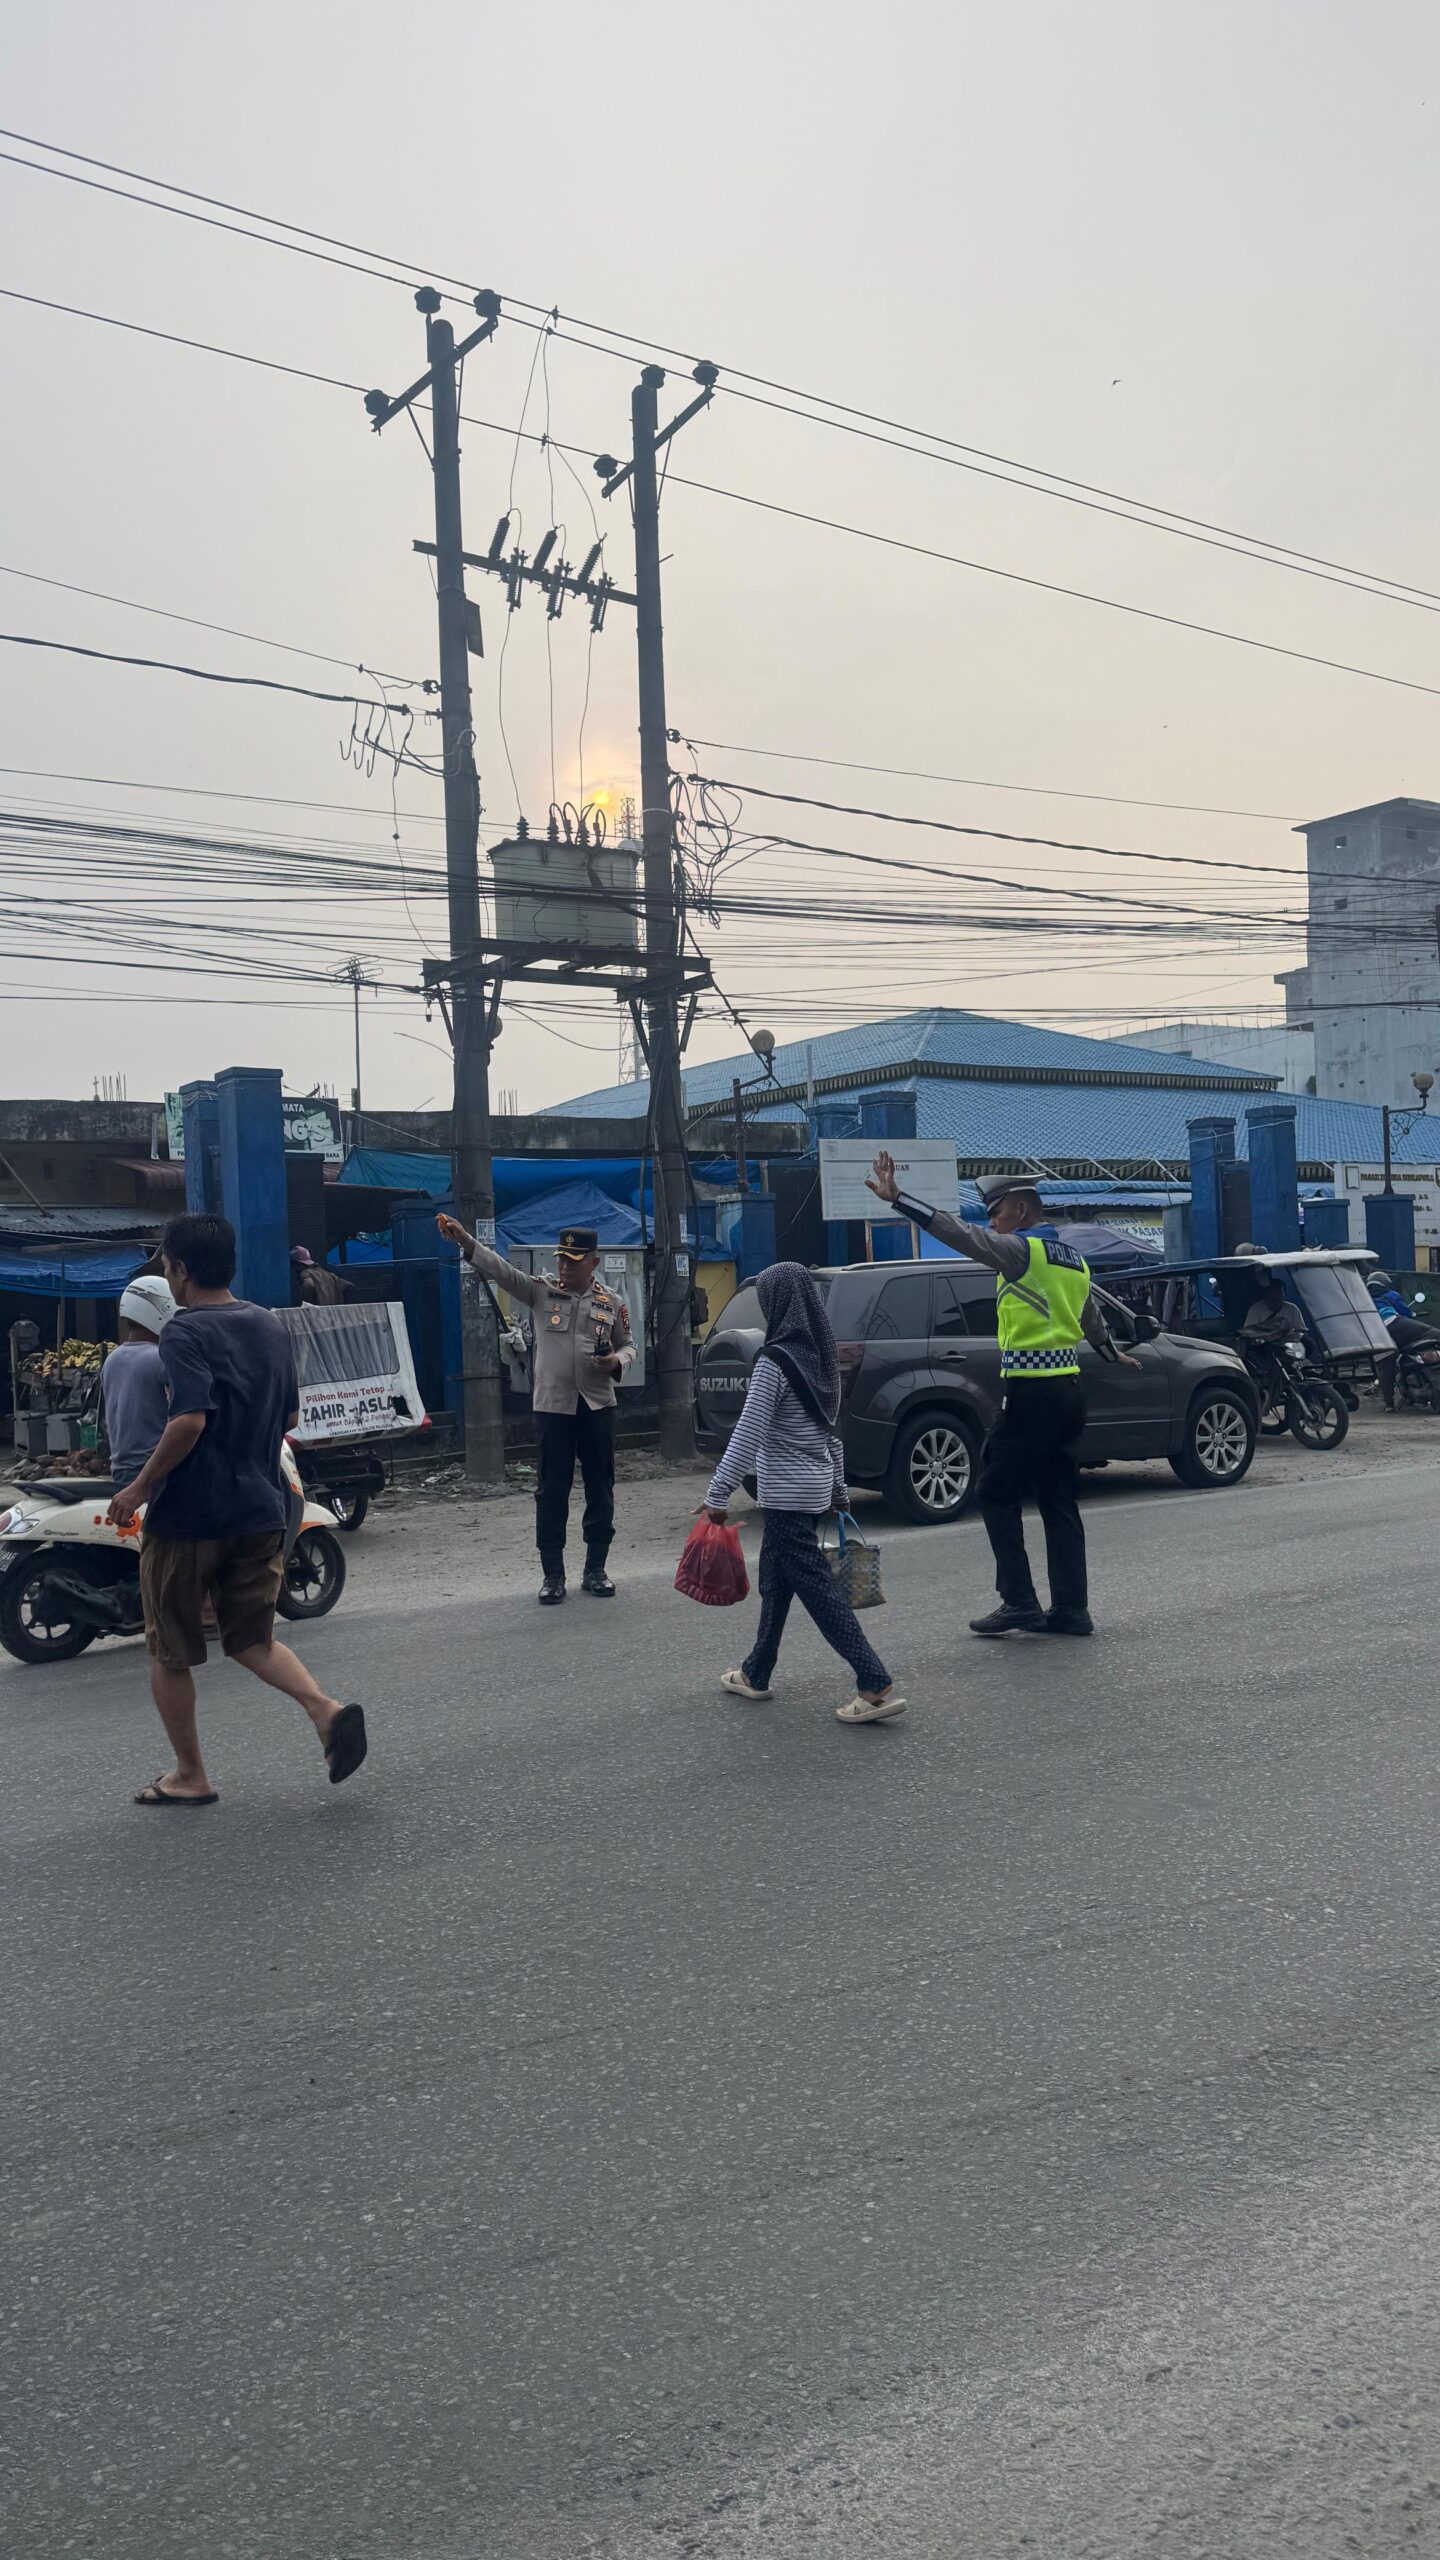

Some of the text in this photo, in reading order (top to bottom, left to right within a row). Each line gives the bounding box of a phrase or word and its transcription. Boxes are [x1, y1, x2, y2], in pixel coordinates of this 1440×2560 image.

[700, 1377, 751, 1392] SUZUKI
[305, 1393, 336, 1404] Pilihan
[337, 1389, 359, 1399] Kami
[360, 1386, 385, 1396] Tetap
[302, 1403, 346, 1423] ZAHIR
